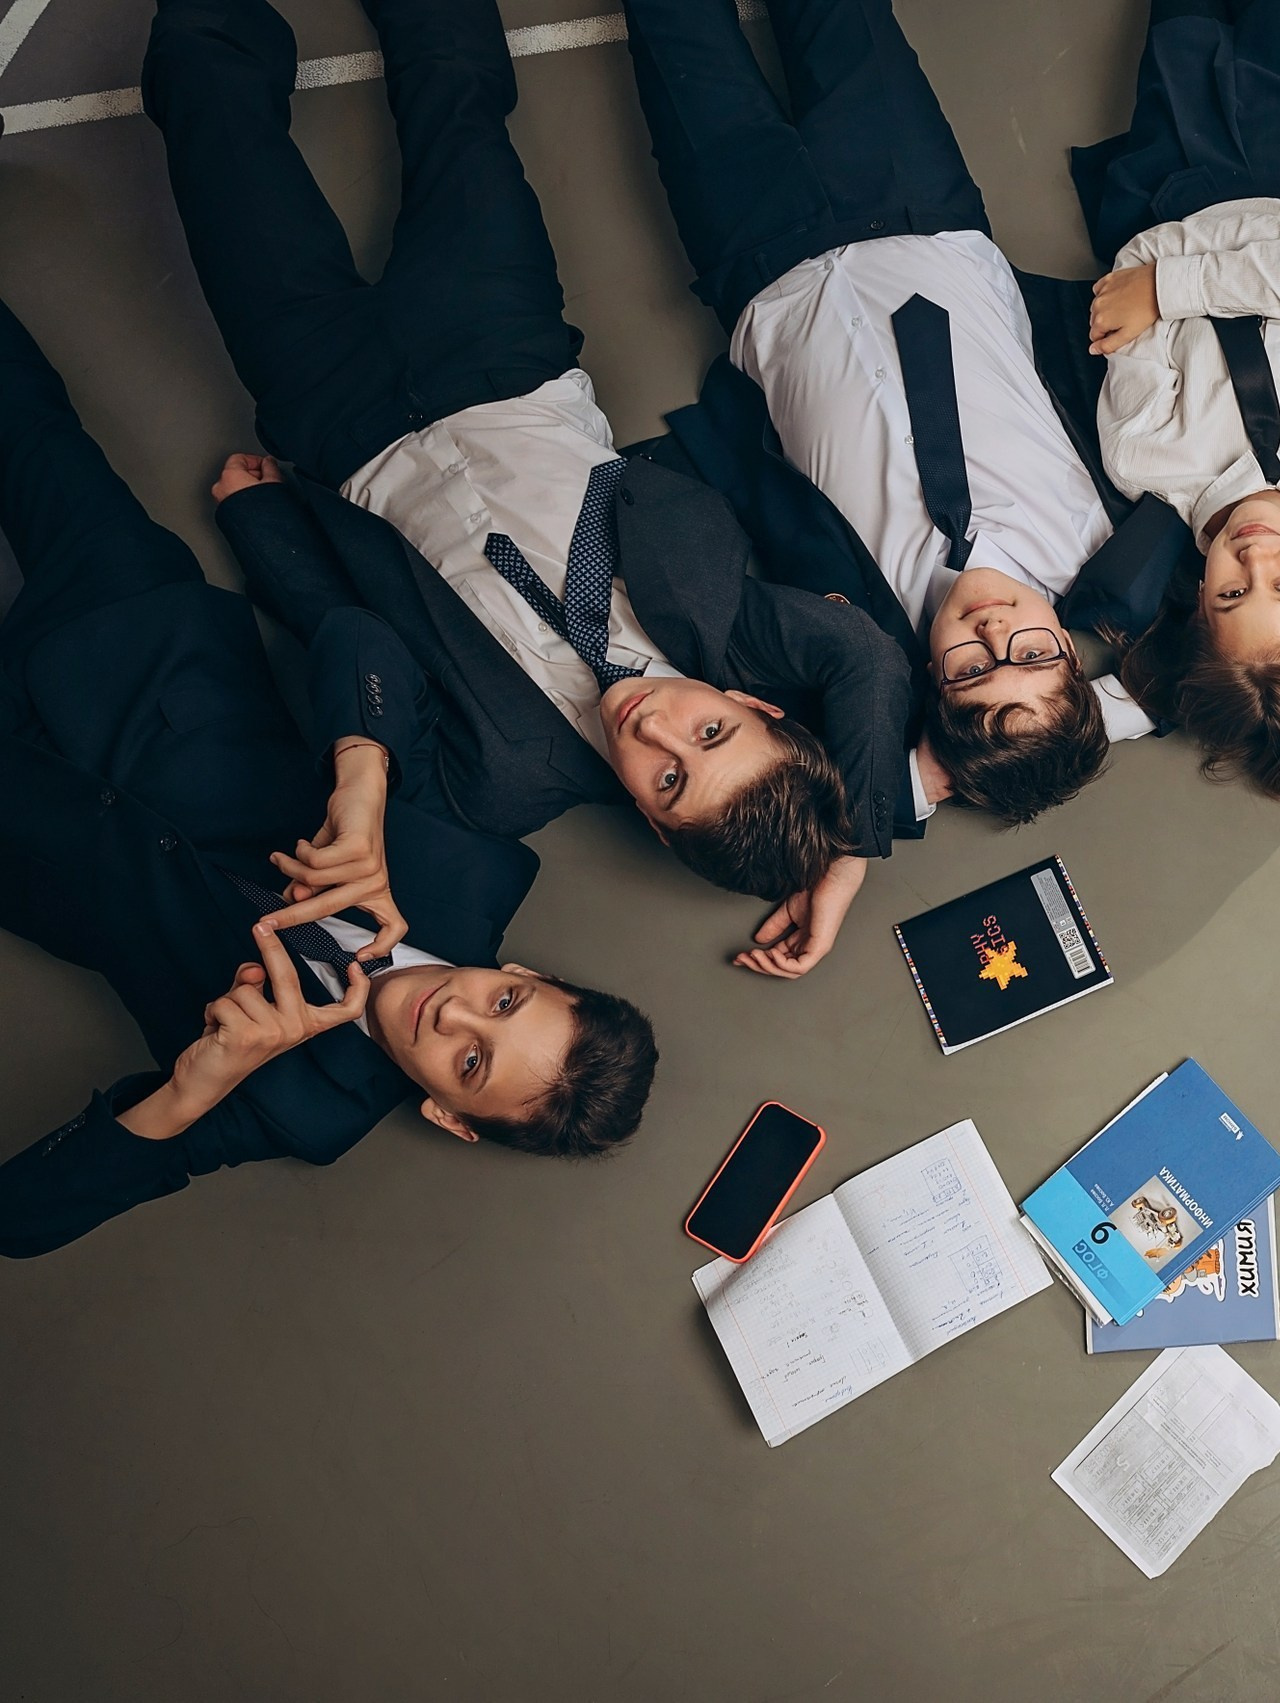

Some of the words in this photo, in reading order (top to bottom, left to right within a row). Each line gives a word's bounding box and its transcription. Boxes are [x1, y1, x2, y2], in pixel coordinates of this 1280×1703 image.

[970, 934, 994, 964] PHY
[1159, 1166, 1213, 1228] ИНФОРМАТИКА
[1091, 1221, 1117, 1244] 9
[1074, 1242, 1108, 1280] ФГОС
